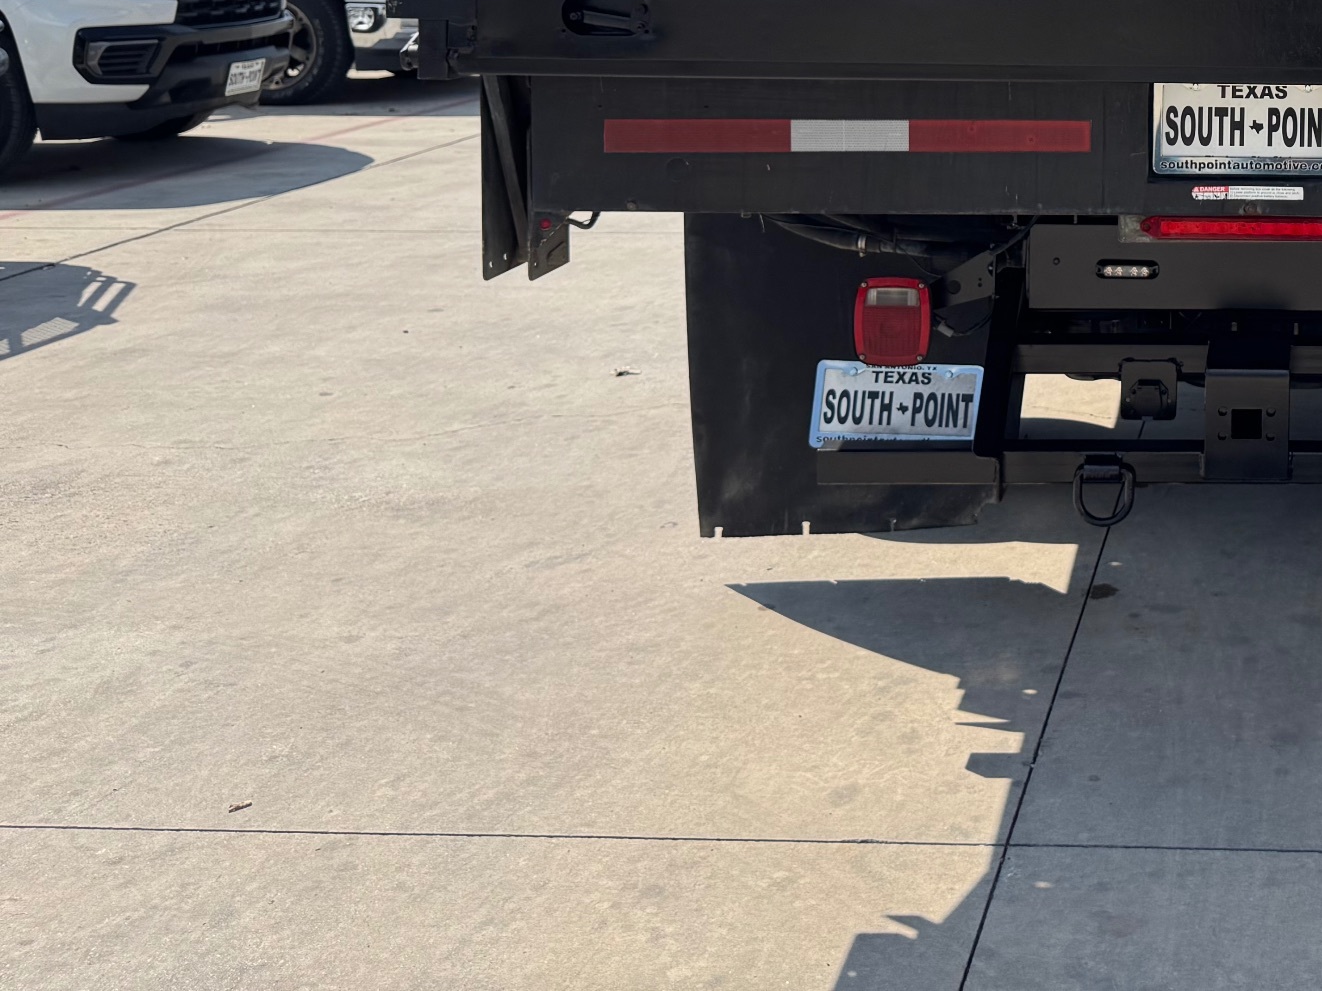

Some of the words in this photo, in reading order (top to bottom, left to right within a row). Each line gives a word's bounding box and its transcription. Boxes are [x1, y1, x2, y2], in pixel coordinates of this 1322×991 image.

[1217, 84, 1288, 100] TEXAS
[1165, 105, 1245, 147] SOUTH
[872, 370, 933, 386] TEXAS
[823, 388, 895, 426] SOUTH
[910, 391, 975, 429] POINT
